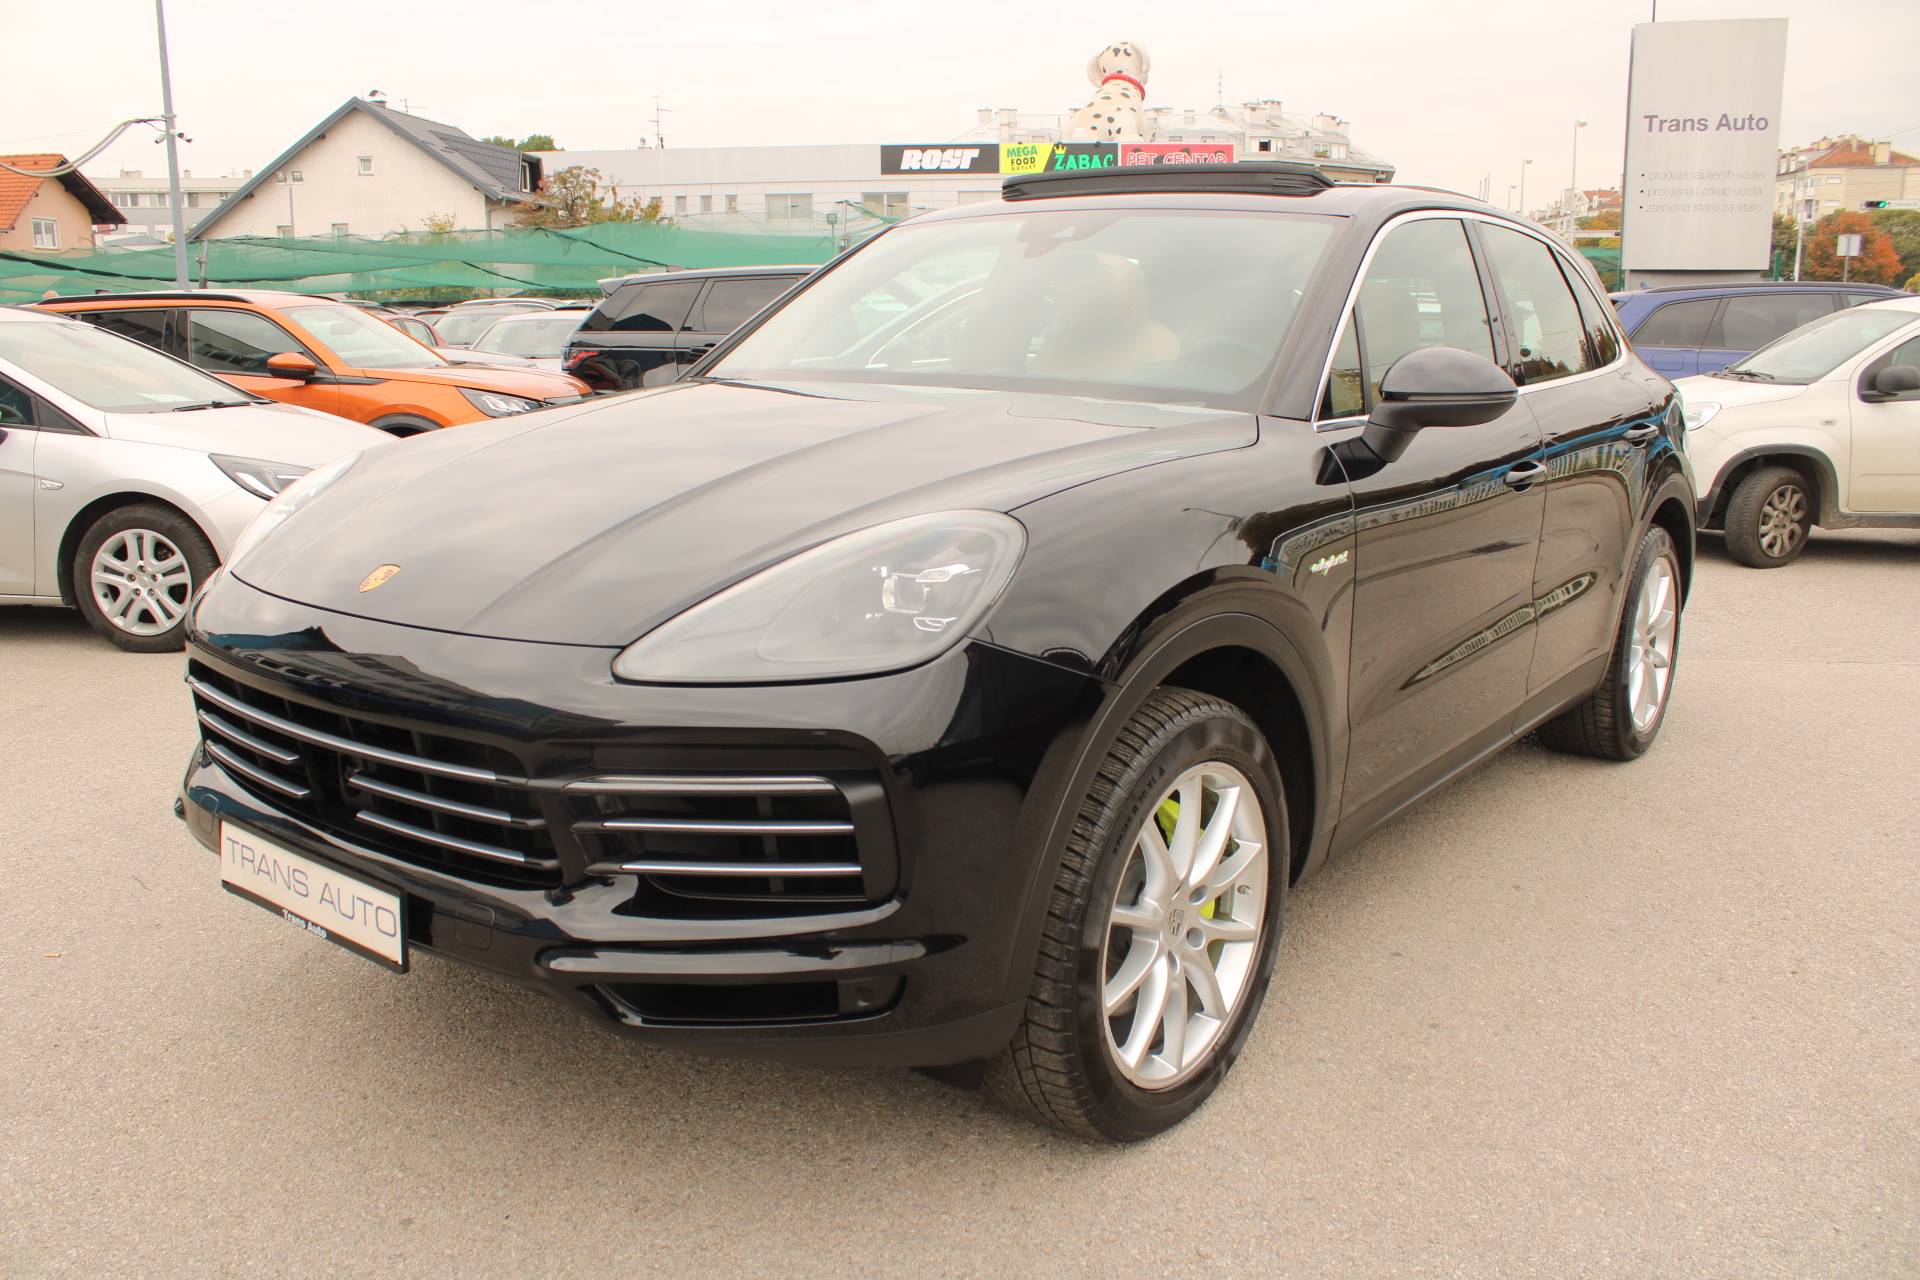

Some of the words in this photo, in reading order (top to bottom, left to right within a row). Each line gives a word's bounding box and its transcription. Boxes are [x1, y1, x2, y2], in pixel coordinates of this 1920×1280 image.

[1644, 114, 1708, 133] Trans
[1715, 113, 1769, 132] Auto
[900, 148, 980, 170] ROST
[1007, 145, 1038, 158] MEGA
[1011, 157, 1036, 166] FOOD
[1127, 152, 1158, 166] PET
[1163, 152, 1228, 165] CENTAR
[226, 837, 309, 898] TRANS
[319, 882, 397, 938] AUTO
[282, 908, 306, 929] Trans
[307, 920, 327, 939] Auto
